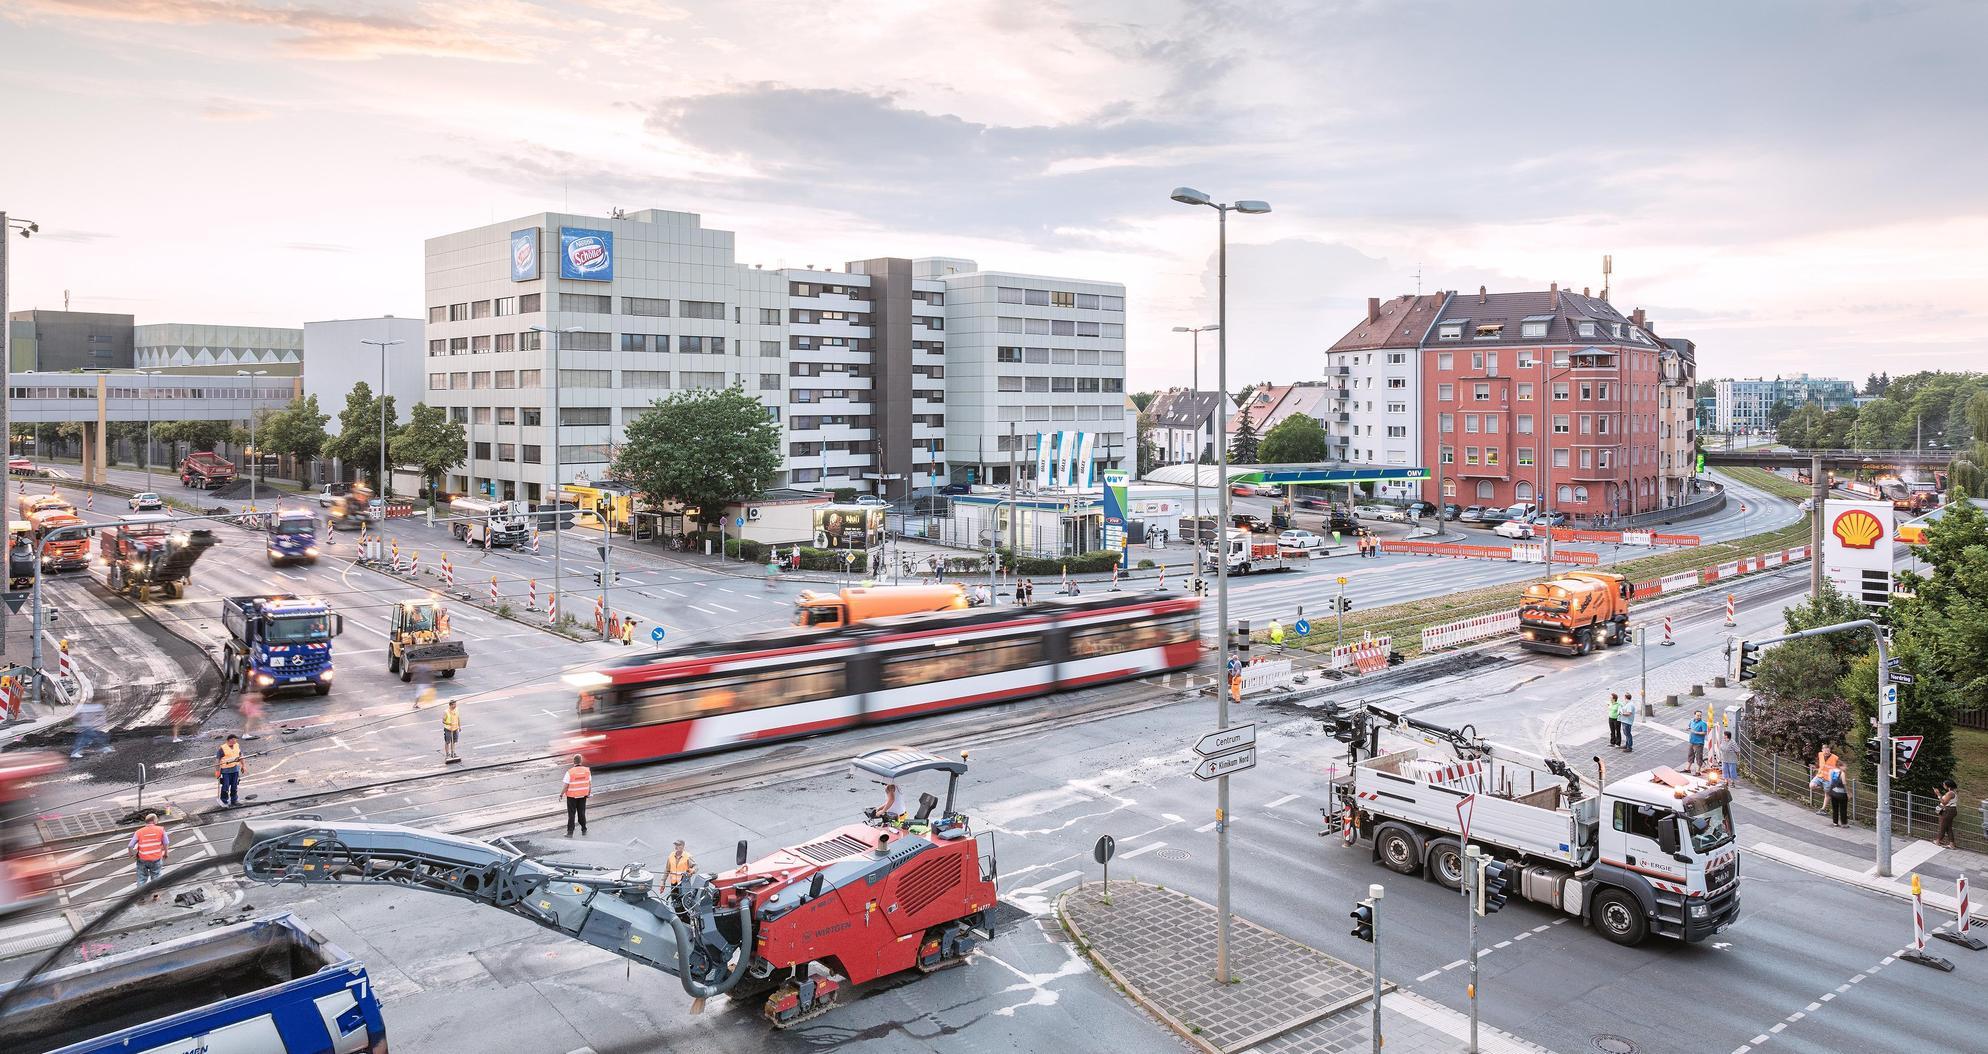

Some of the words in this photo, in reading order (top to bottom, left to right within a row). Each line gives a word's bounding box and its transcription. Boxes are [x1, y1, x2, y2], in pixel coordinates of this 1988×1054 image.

[575, 248, 602, 265] Schöller
[1890, 674, 1911, 682] Nordring
[1216, 736, 1240, 746] Centrum
[1219, 760, 1238, 769] Klinikum
[1239, 755, 1249, 764] Nord
[1715, 871, 1729, 883] MAN
[815, 921, 851, 937] WIRTGEN
